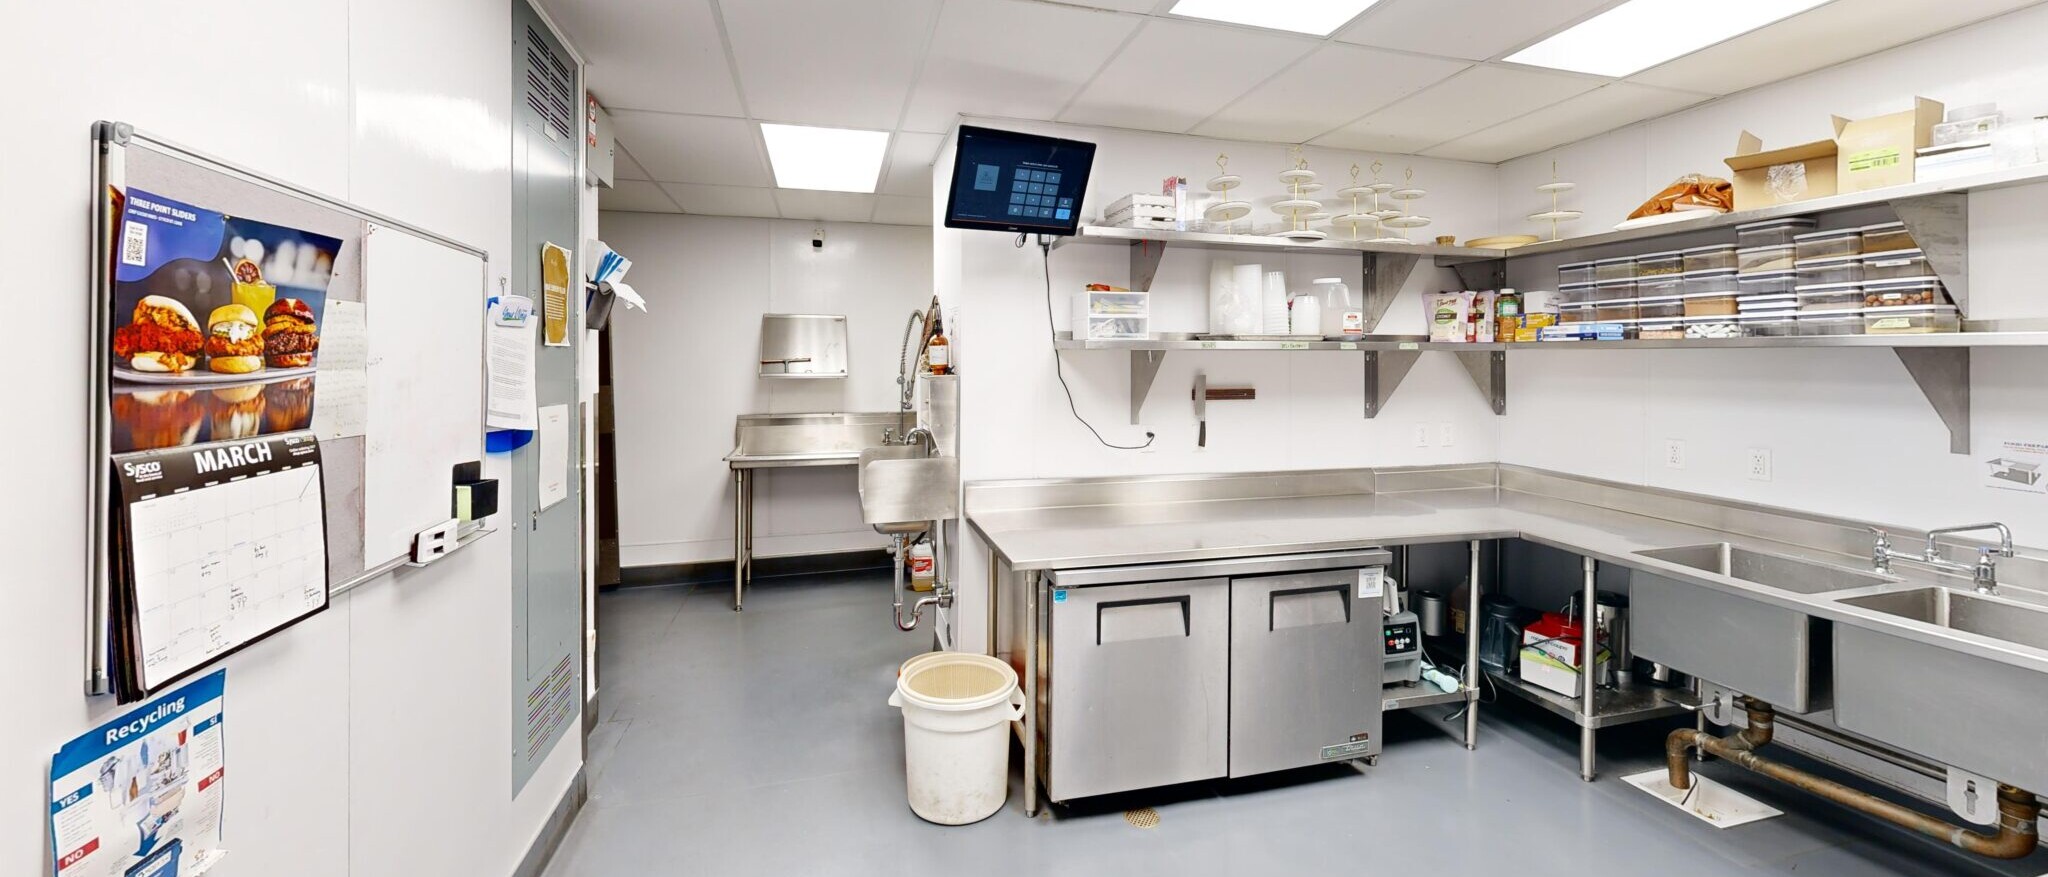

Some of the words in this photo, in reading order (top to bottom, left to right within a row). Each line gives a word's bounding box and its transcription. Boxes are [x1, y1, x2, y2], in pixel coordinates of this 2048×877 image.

[130, 196, 150, 209] THREE
[150, 203, 171, 215] POINT
[172, 208, 197, 222] SLIDERS
[193, 441, 272, 474] MARCH
[123, 461, 161, 478] Sysco
[105, 696, 186, 745] Recycling
[208, 771, 221, 783] NO
[58, 791, 80, 808] YES
[64, 849, 85, 866] NO
